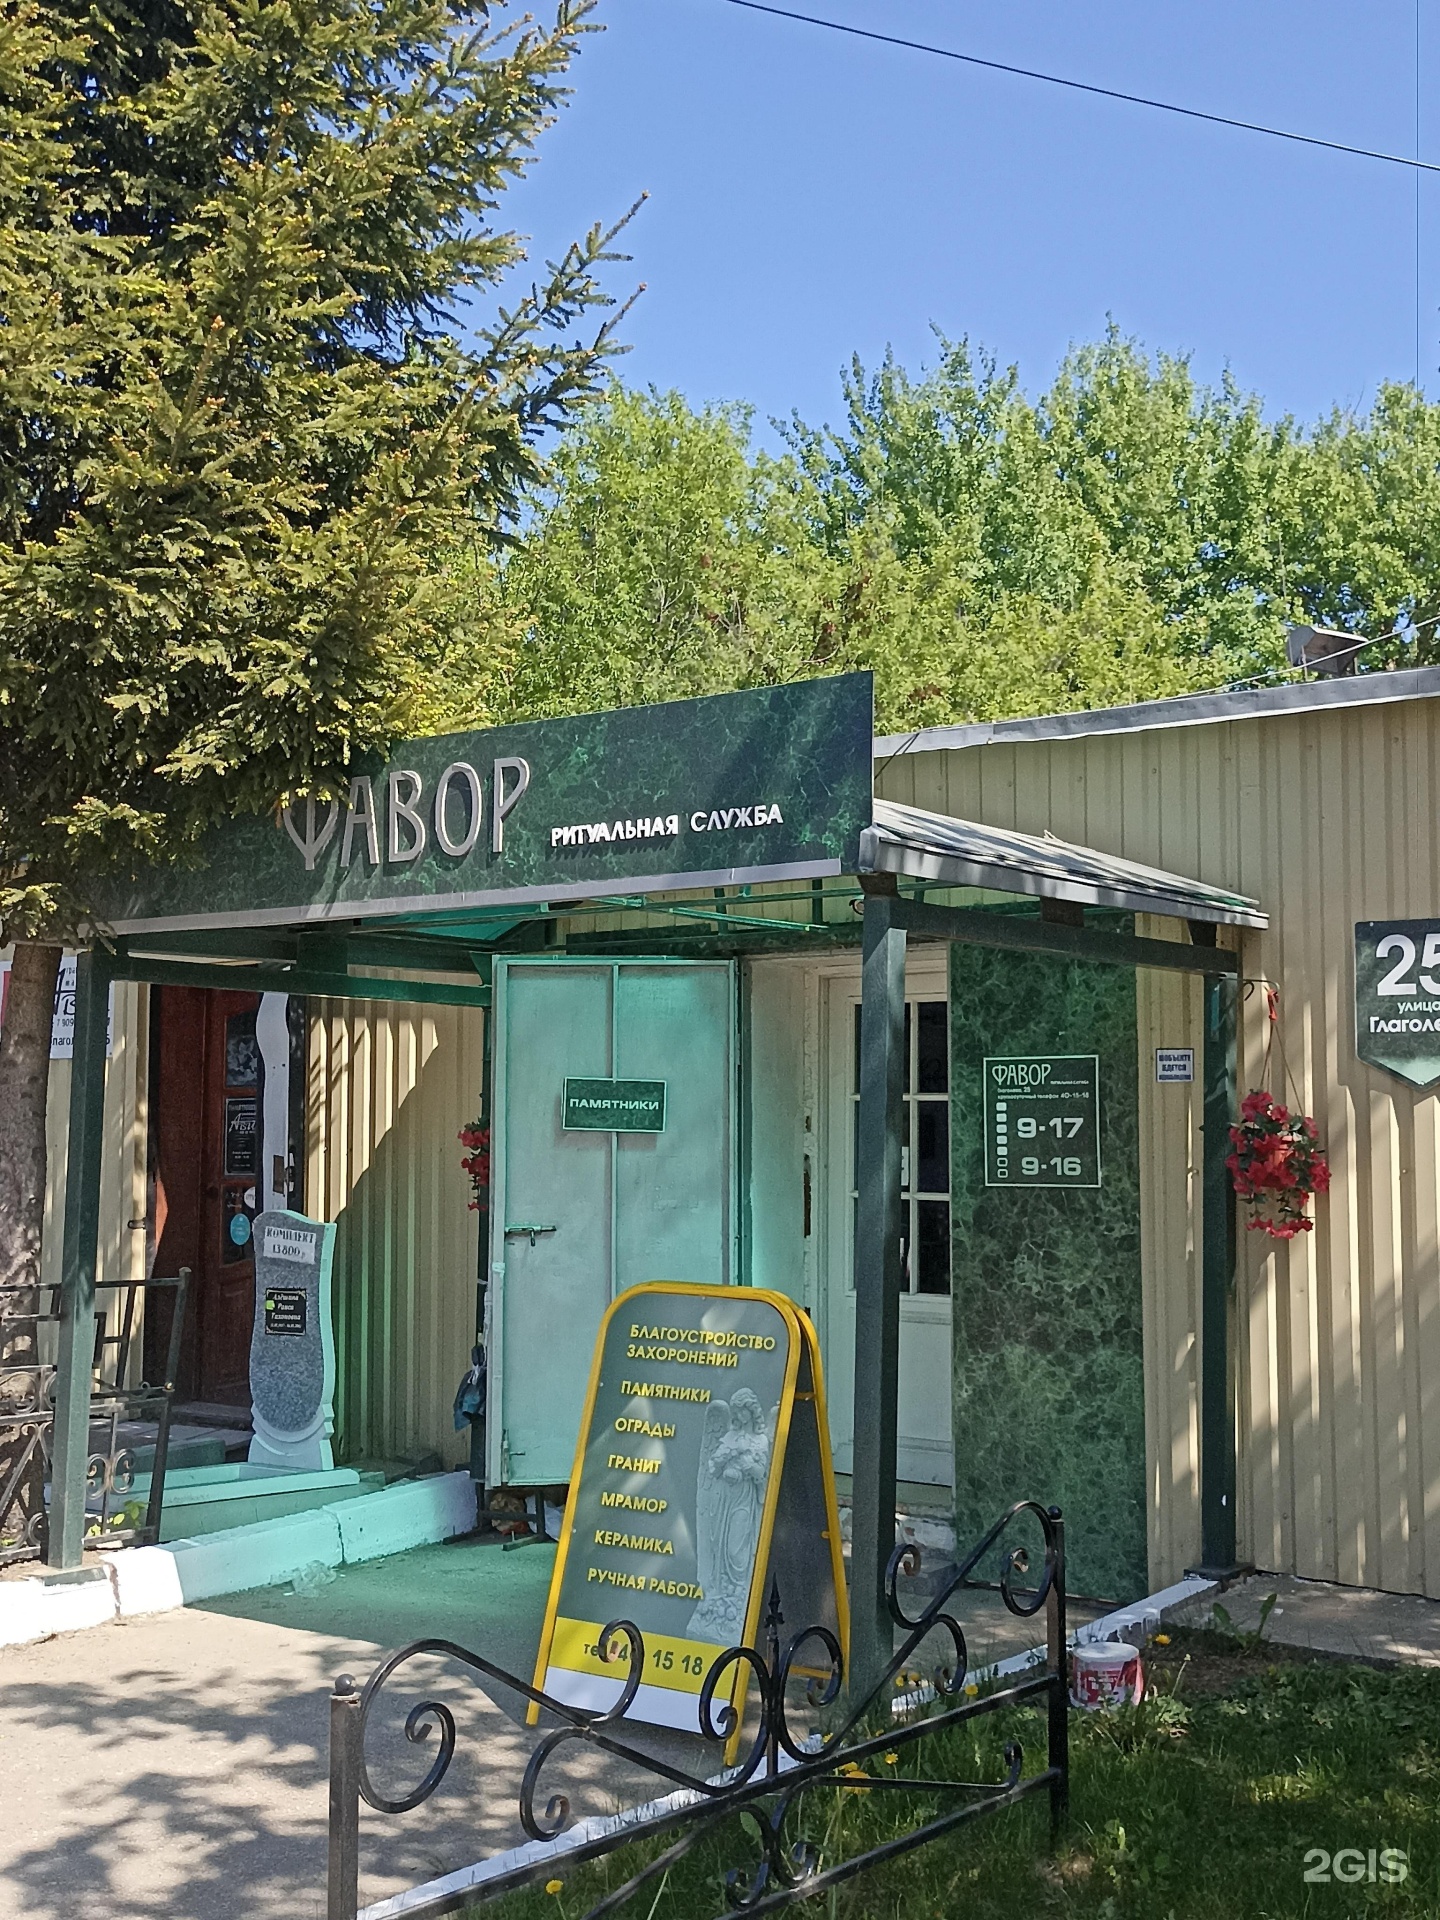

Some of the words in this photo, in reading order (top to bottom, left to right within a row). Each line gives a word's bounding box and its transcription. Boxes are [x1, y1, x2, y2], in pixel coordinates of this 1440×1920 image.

[283, 756, 530, 871] ФАВОР
[551, 814, 678, 847] РИТУАЛЬНАЯ
[690, 803, 784, 833] СЛУЖБА
[1397, 1001, 1440, 1014] улица
[991, 1064, 1052, 1086] ФАВОР
[569, 1098, 660, 1111] ПАМЯТНИКИ
[629, 1324, 776, 1351] БЛАГОУСТРОЙСТВО
[626, 1344, 739, 1368] ЗАХОРОНЕНИЙ
[620, 1380, 712, 1404] ПАМЯТНИКИ
[614, 1417, 676, 1438] ОГРАДЫ
[607, 1454, 662, 1474] ГРАНИТ
[601, 1491, 668, 1513] МРАМОР
[594, 1529, 674, 1555] КЕРАМИКА
[587, 1567, 646, 1591] РУЧНАЯ
[649, 1576, 705, 1600] РАБОТА
[652, 1649, 674, 1671] 15
[681, 1654, 703, 1676] 18
